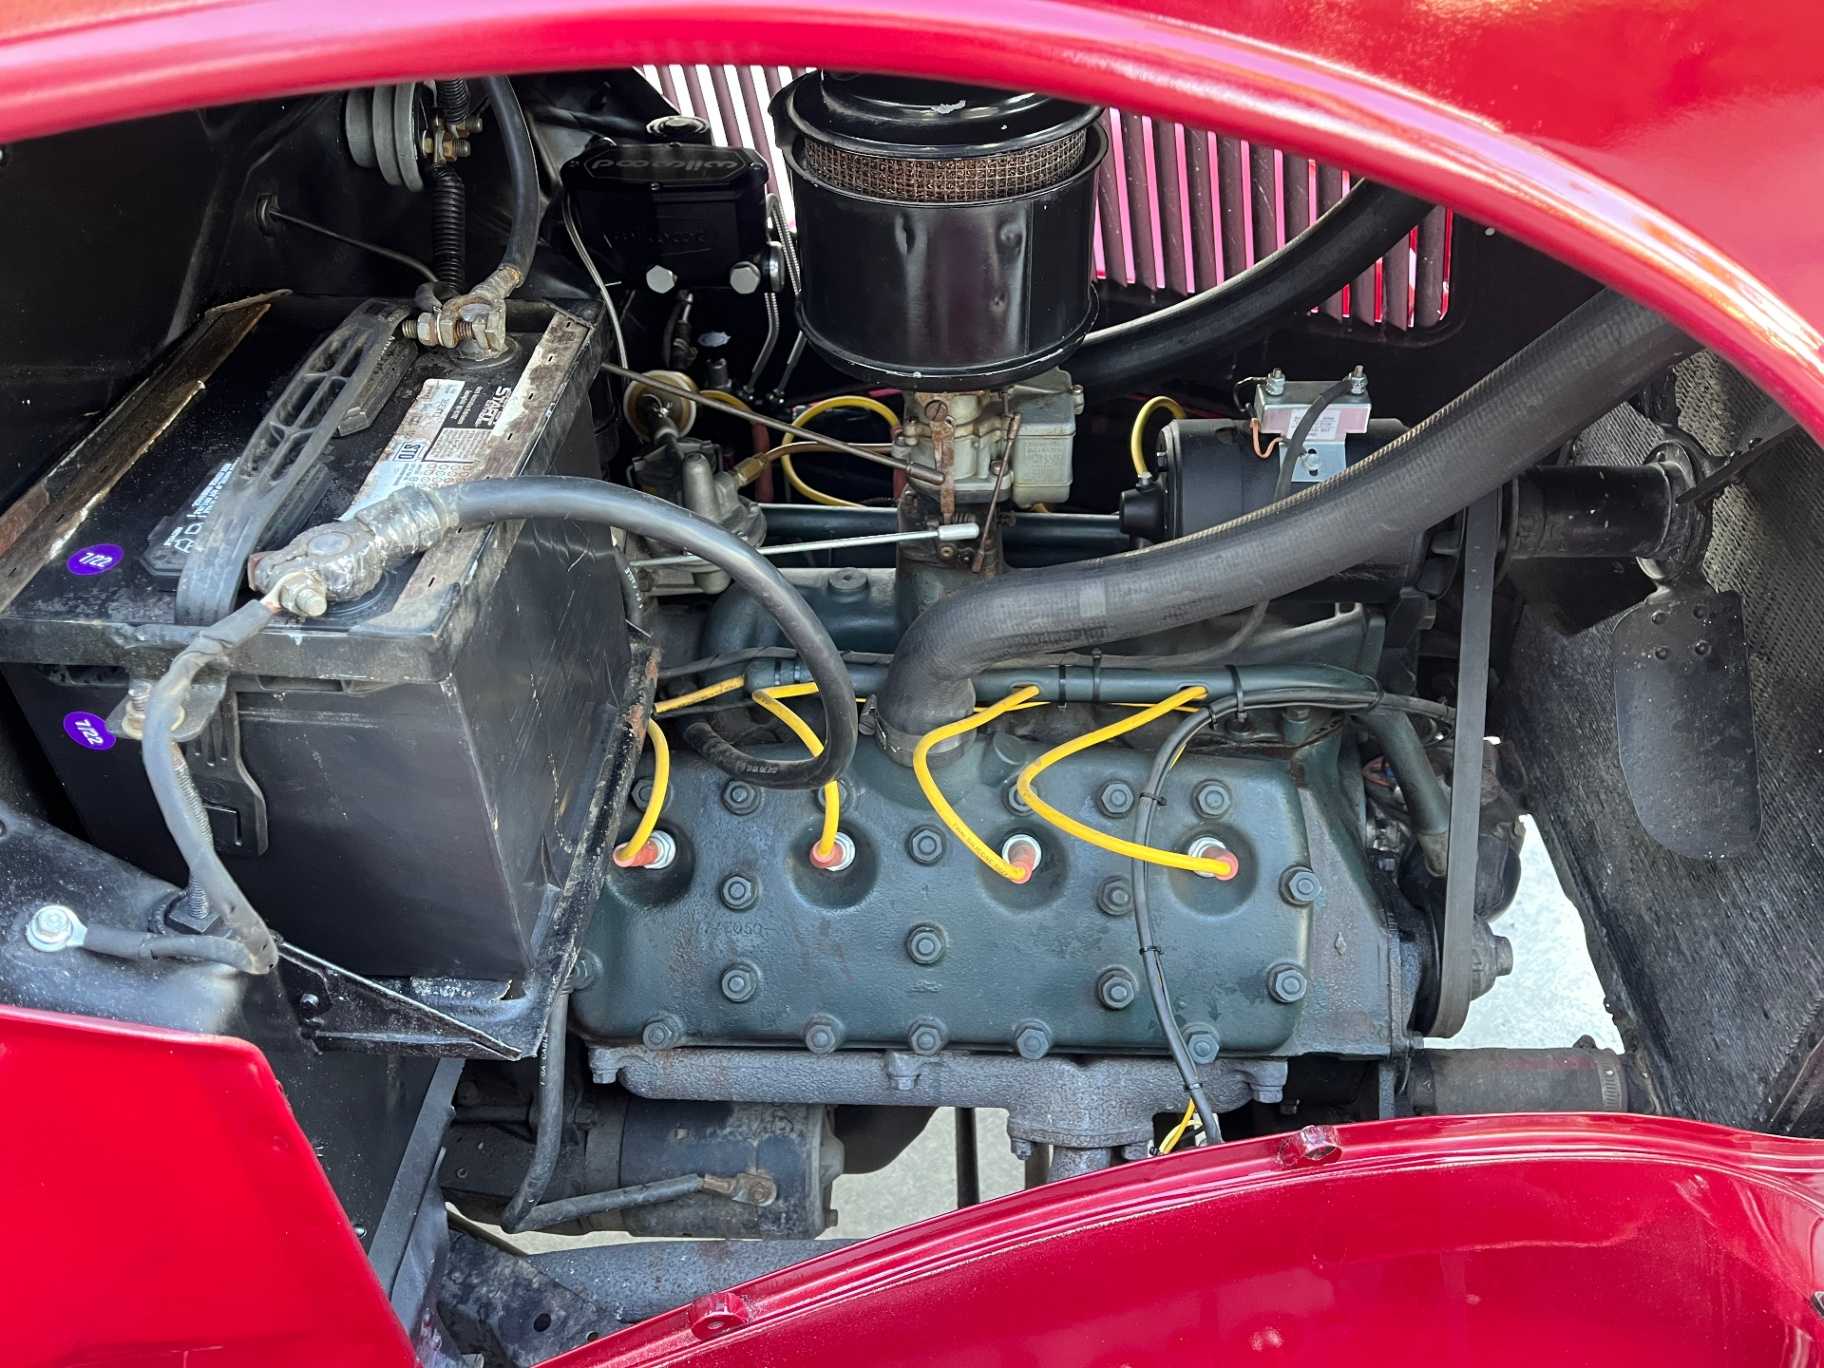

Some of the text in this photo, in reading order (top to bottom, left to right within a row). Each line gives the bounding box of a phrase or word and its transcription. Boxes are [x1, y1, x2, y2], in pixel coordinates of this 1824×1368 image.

[592, 159, 738, 171] wilwood
[79, 553, 112, 568] 7/22
[75, 719, 104, 745] 7/22
